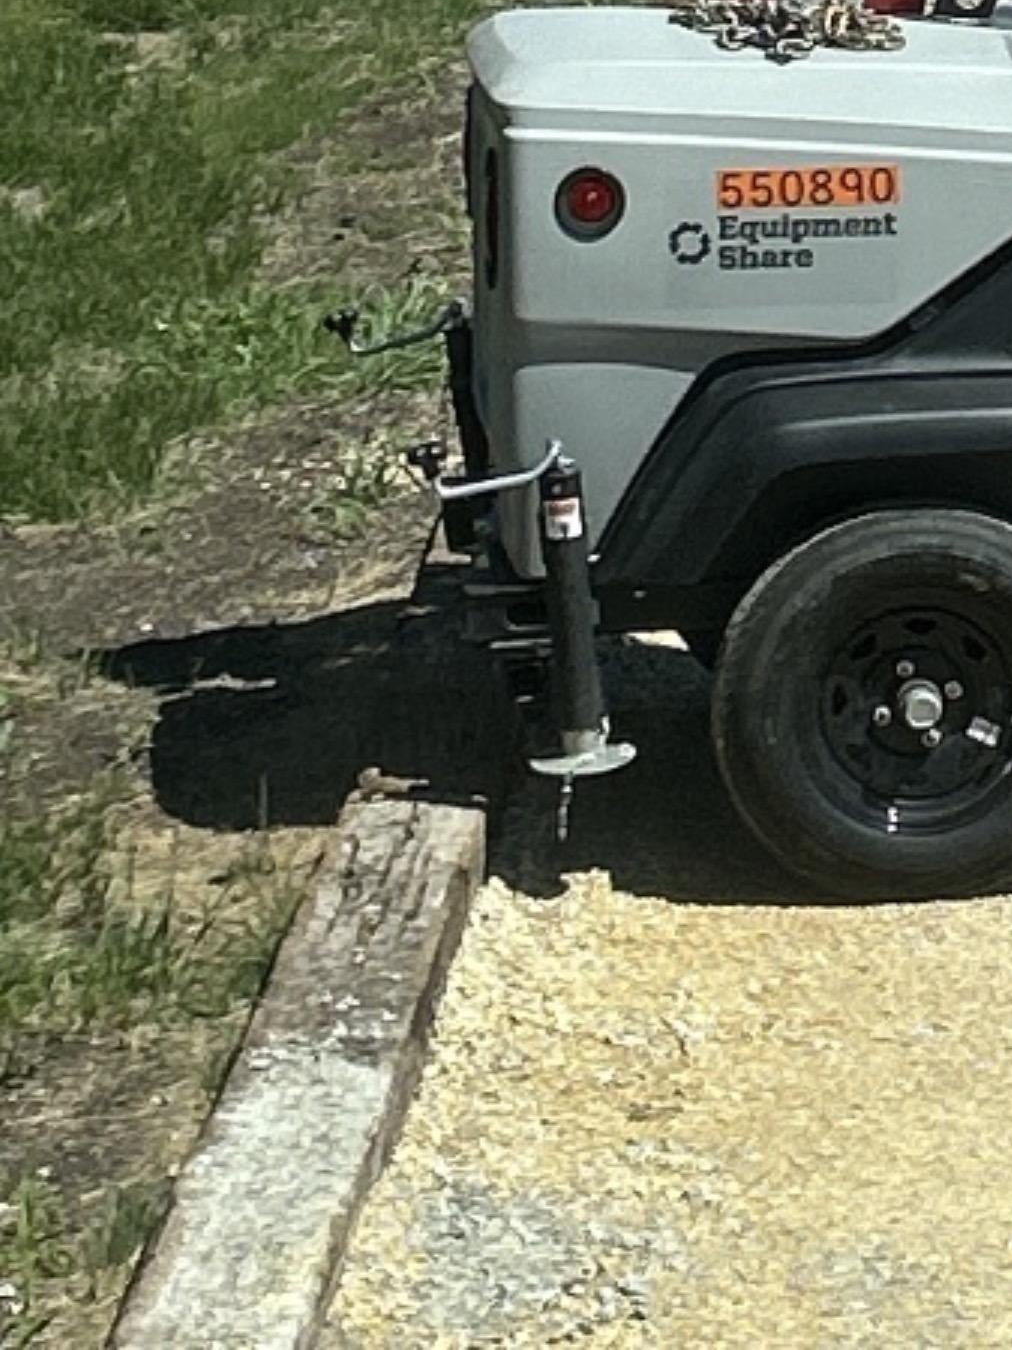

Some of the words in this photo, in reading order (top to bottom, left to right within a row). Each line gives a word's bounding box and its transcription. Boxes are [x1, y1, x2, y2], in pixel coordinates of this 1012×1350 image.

[718, 167, 896, 209] 550890
[718, 212, 897, 242] Equipment
[718, 245, 813, 270] Share
